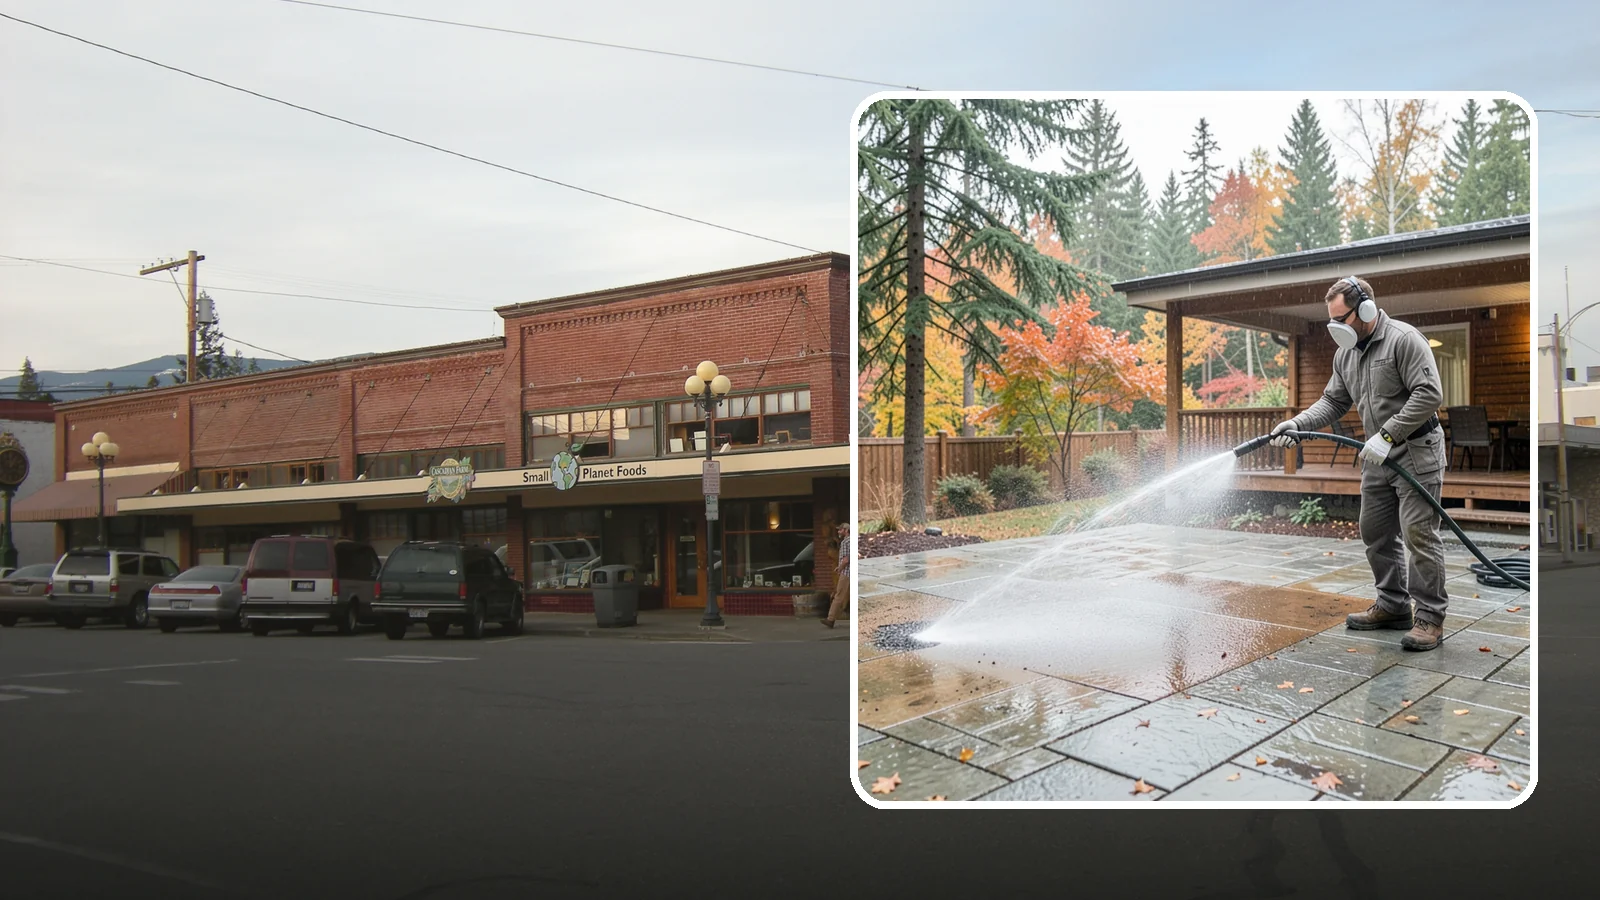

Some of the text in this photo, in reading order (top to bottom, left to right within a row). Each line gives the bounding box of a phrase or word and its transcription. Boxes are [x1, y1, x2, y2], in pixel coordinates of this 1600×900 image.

[523, 464, 646, 482] Small Planet Foods
